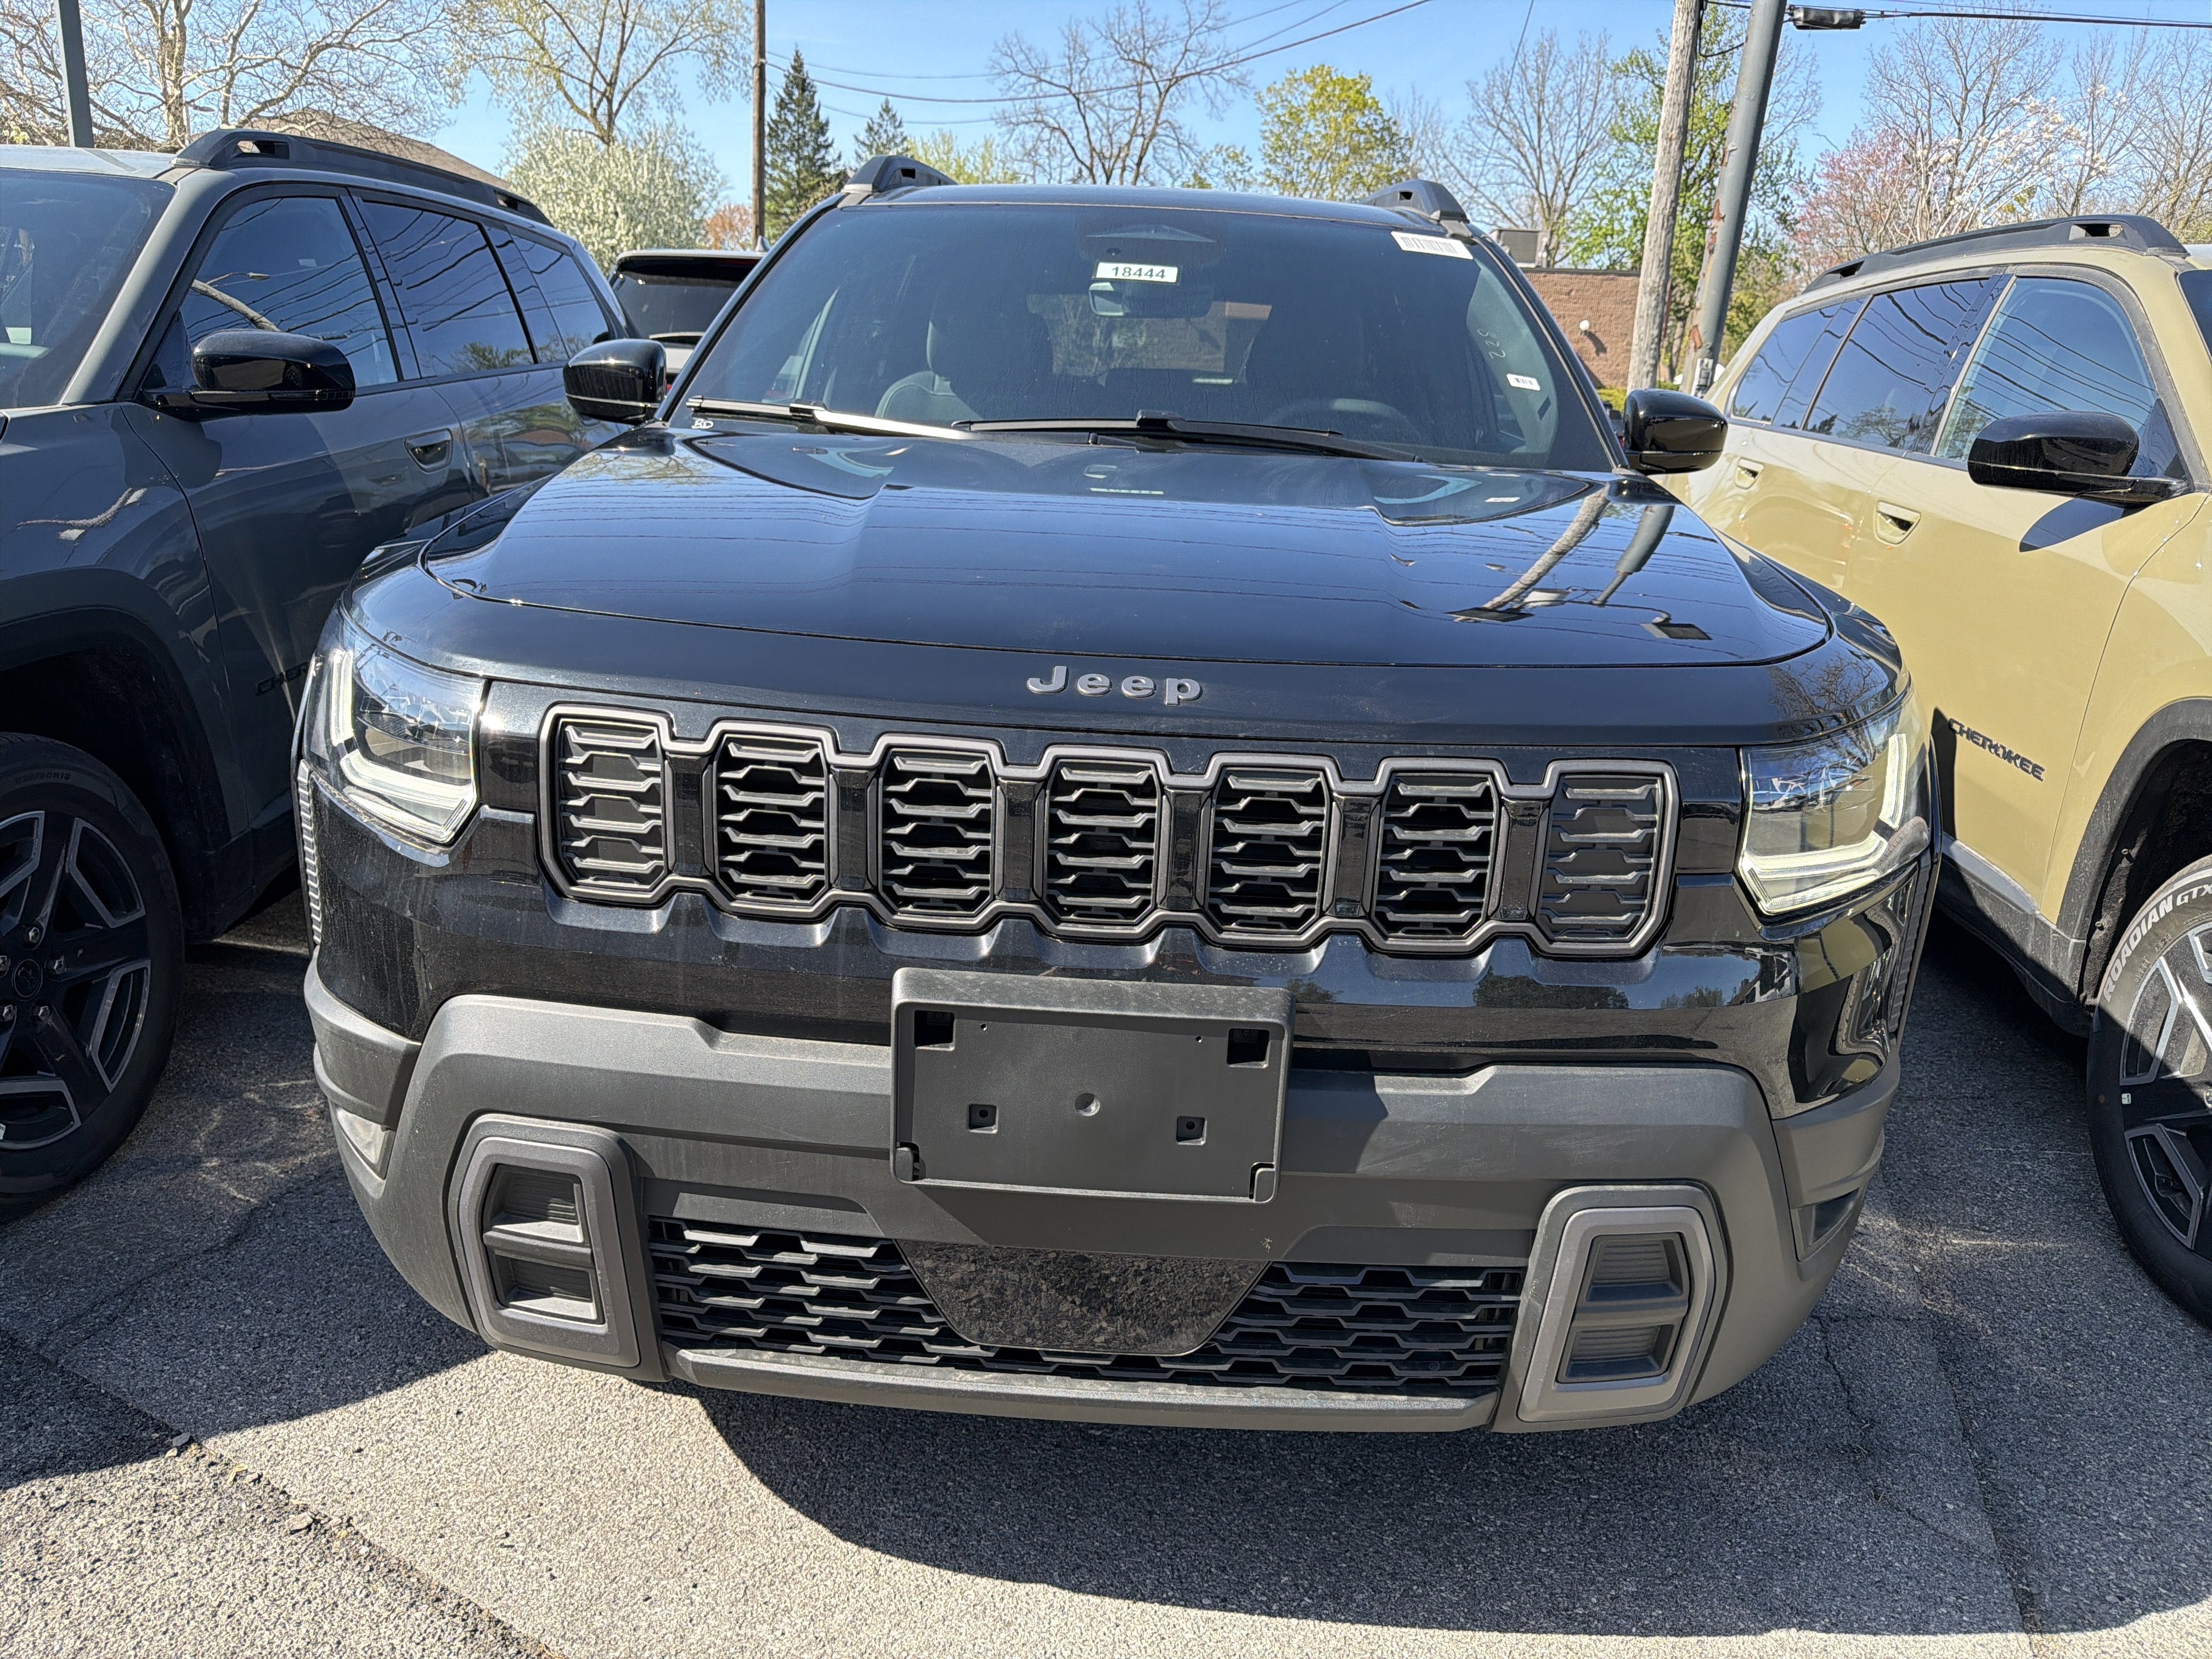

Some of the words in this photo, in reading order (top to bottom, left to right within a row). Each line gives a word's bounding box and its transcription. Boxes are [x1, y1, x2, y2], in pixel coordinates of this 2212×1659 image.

[1111, 266, 1166, 279] 18444
[1026, 665, 1203, 706] Jeep
[1948, 718, 2046, 782] CHEROKEE
[2103, 894, 2174, 1003] ROADIAN
